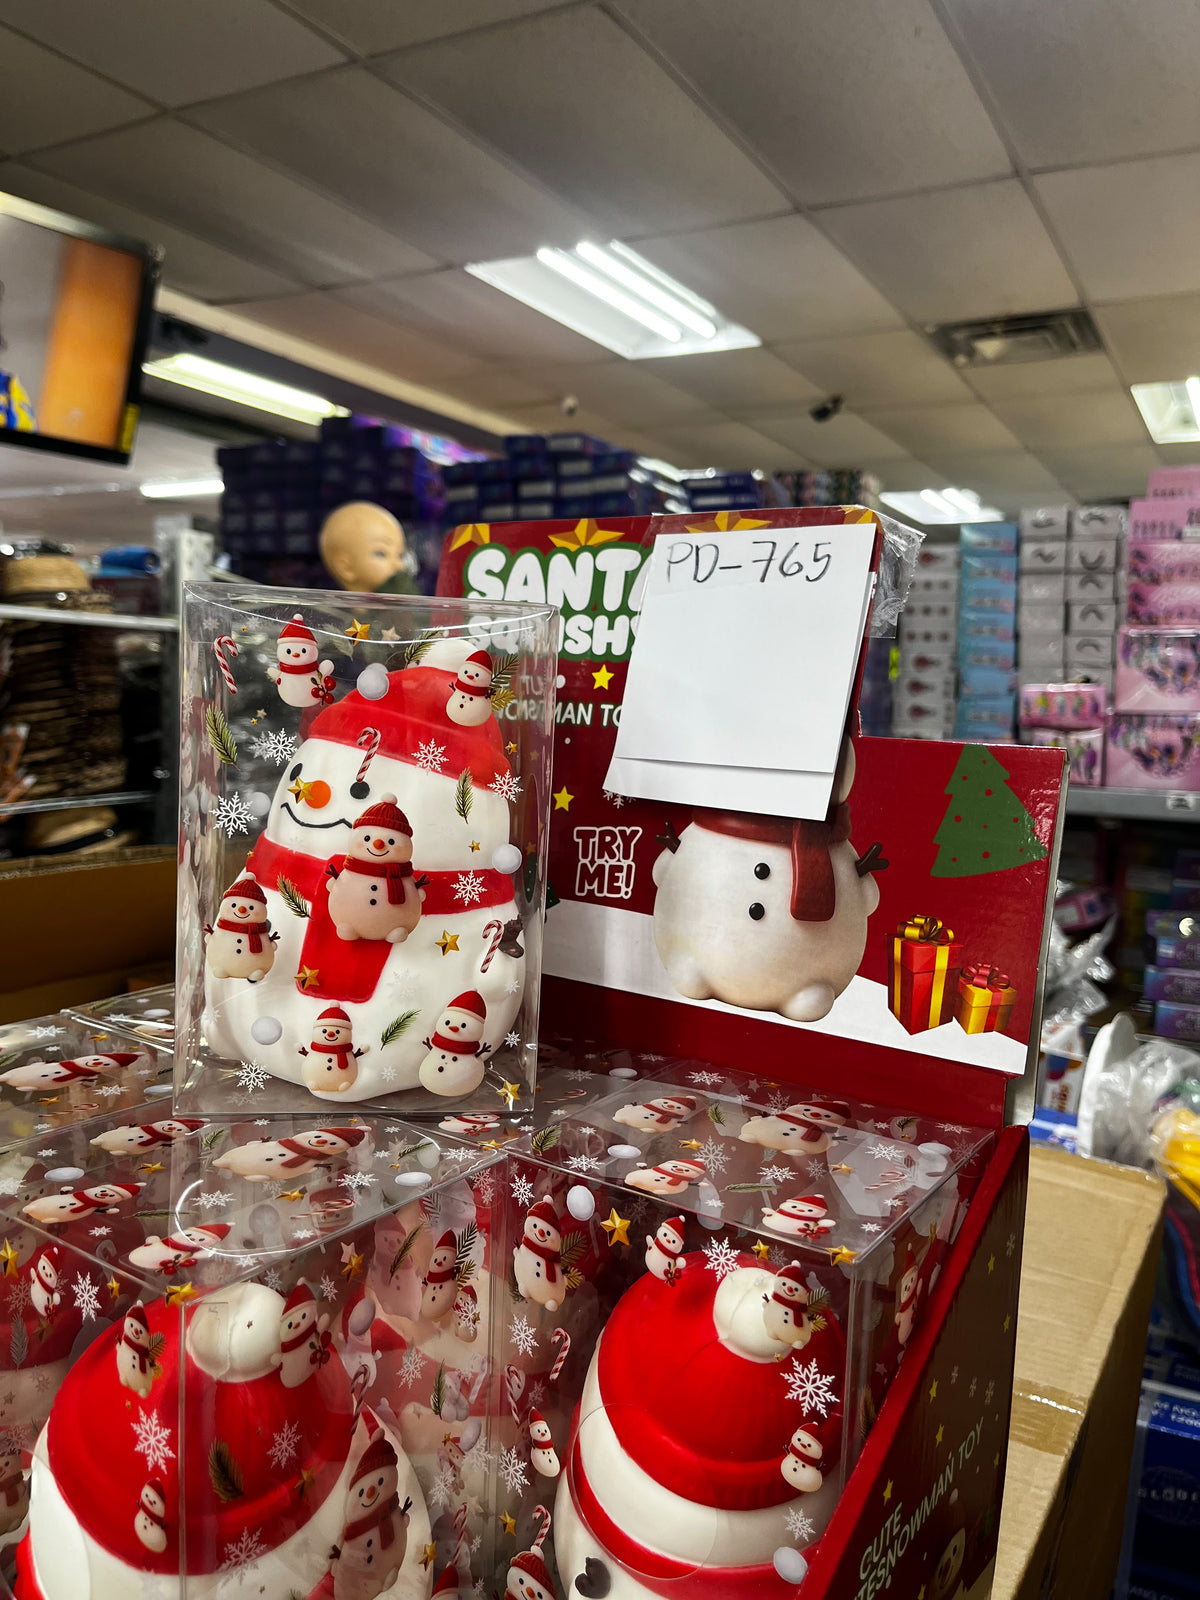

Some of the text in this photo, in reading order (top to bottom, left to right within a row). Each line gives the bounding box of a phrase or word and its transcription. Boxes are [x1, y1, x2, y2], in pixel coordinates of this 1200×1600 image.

[667, 541, 832, 583] PD-765
[573, 826, 643, 862] TRY
[575, 861, 636, 899] ME!
[958, 1416, 984, 1470] TOY
[859, 1501, 903, 1580] CUTE
